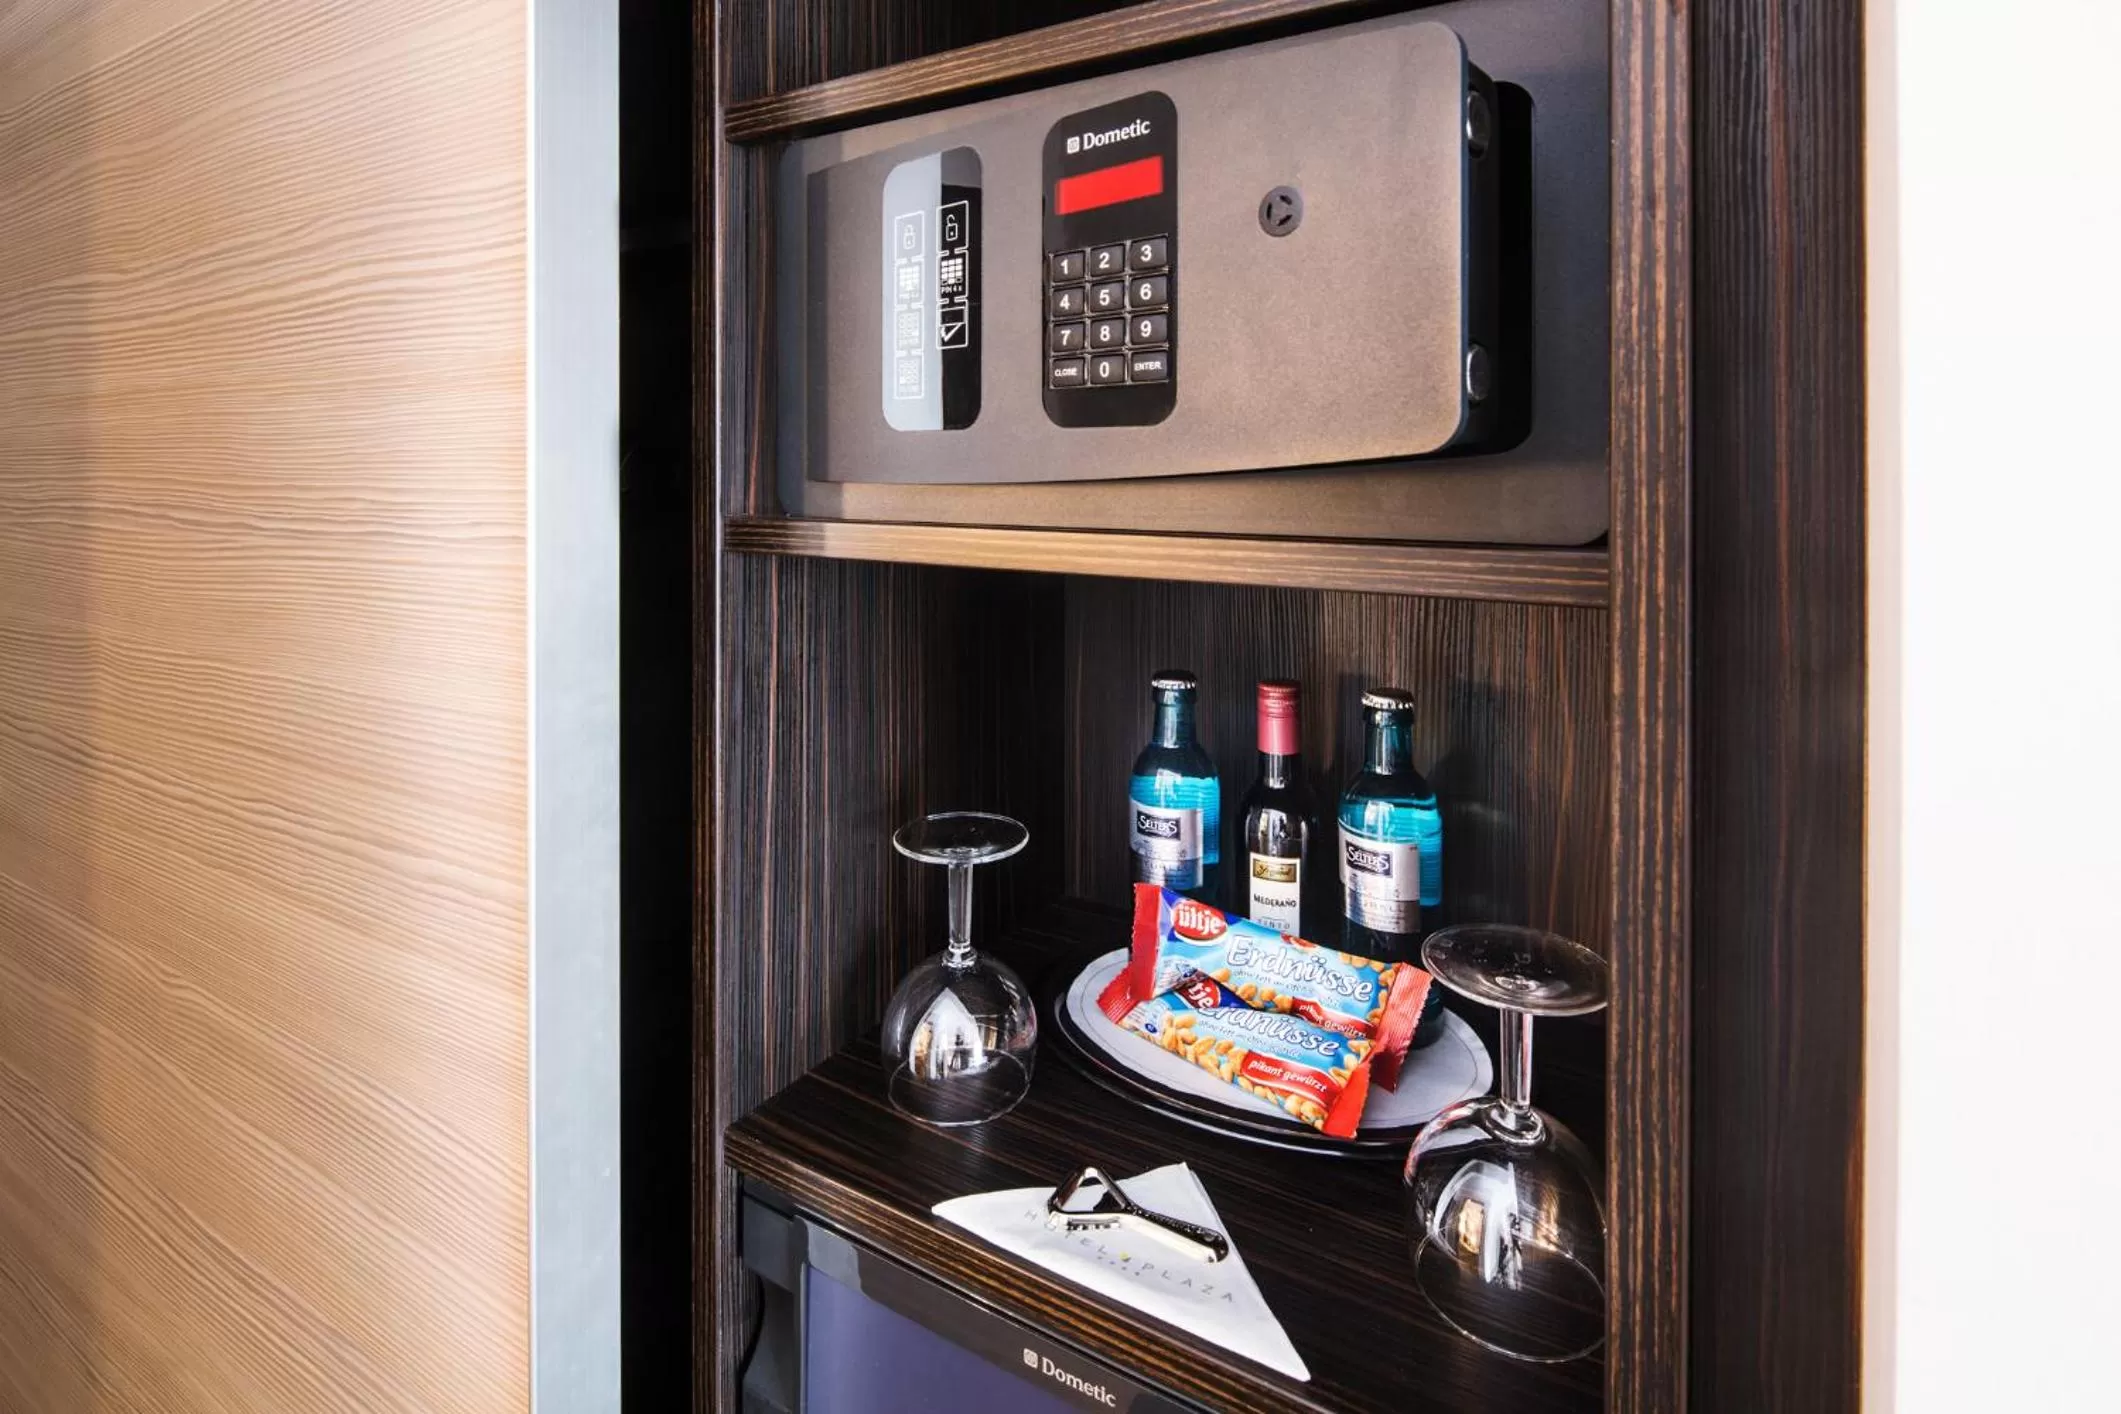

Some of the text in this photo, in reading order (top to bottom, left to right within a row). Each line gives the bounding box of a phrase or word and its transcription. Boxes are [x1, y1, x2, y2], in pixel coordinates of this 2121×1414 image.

[1083, 118, 1151, 151] Dometic
[1060, 244, 1152, 275] 1 2 3
[1059, 283, 1151, 310] 4 5 6
[1060, 320, 1151, 346] 7 8 9
[1054, 361, 1162, 378] CLOSE 0 ENTER
[1178, 902, 1223, 936] ültje
[1226, 934, 1374, 1002] Erdnüsse
[1247, 1060, 1328, 1092] pikant gewürzt
[1142, 1263, 1234, 1302] PLAZA
[1041, 1356, 1117, 1408] Dometic
